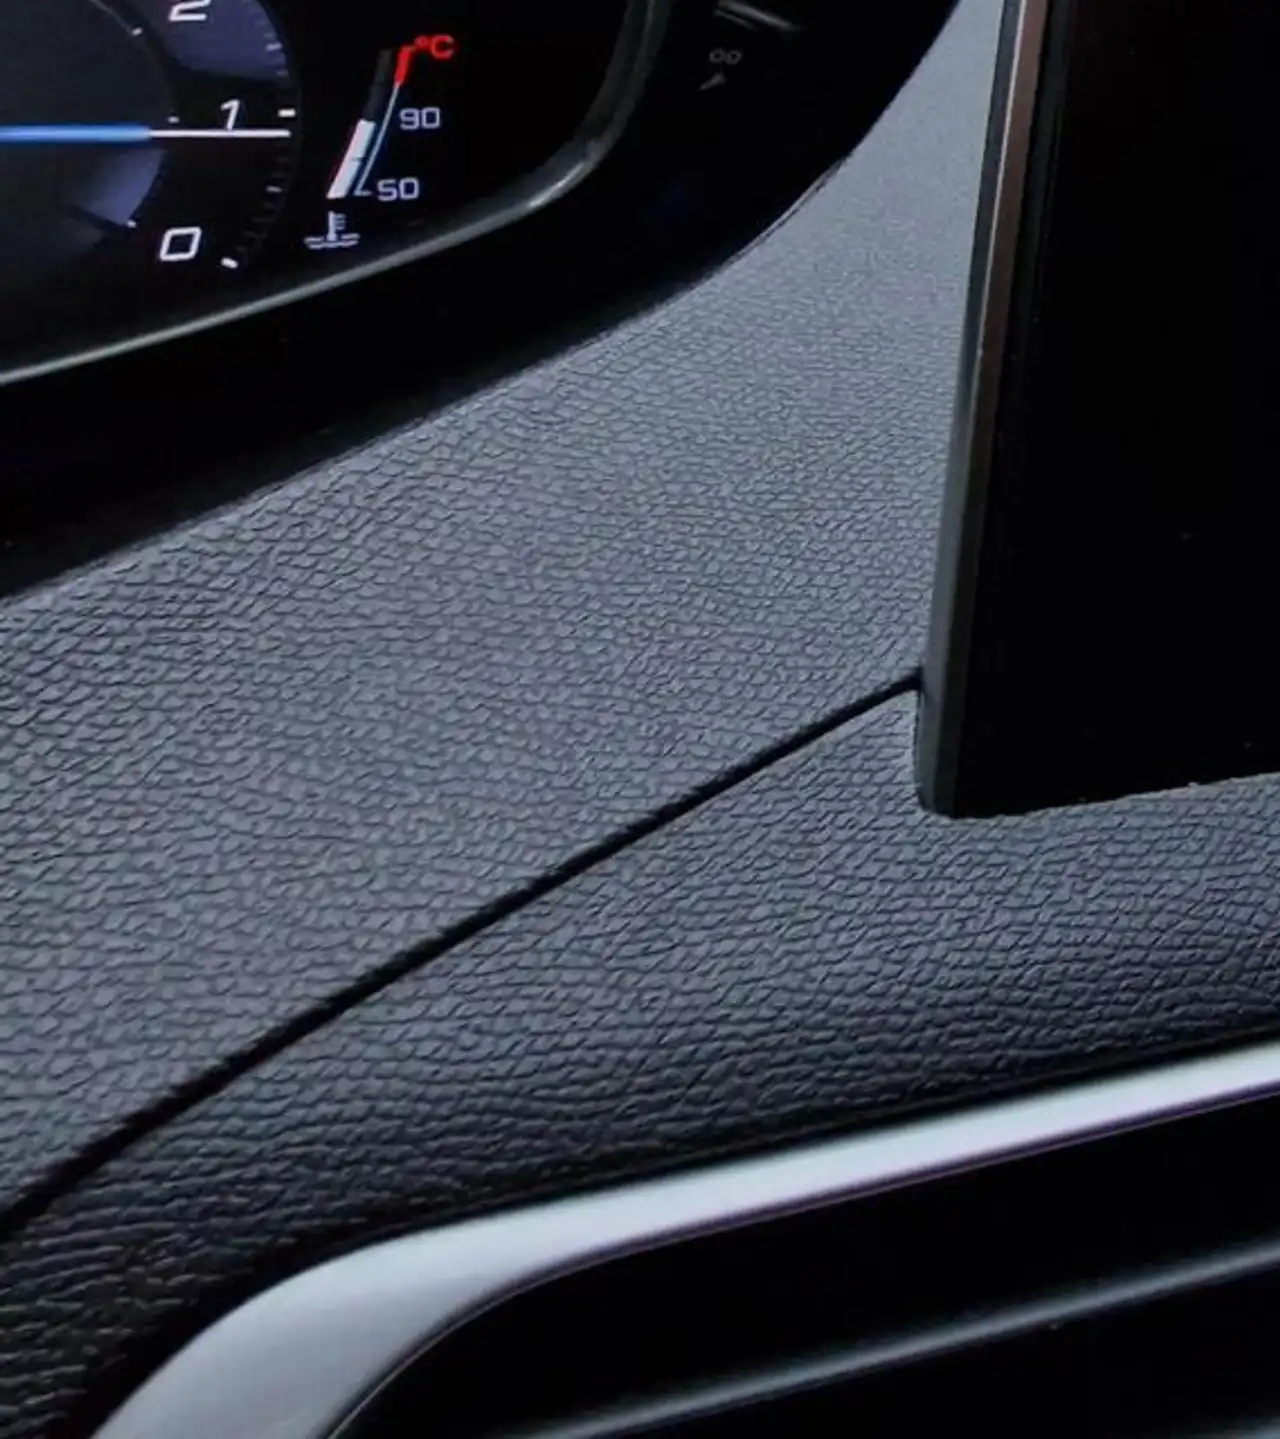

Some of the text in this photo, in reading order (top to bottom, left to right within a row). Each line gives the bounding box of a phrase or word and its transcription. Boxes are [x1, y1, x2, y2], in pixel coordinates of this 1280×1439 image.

[220, 98, 240, 131] 1
[399, 107, 440, 130] 90
[377, 177, 420, 201] 50
[158, 226, 202, 262] 0
